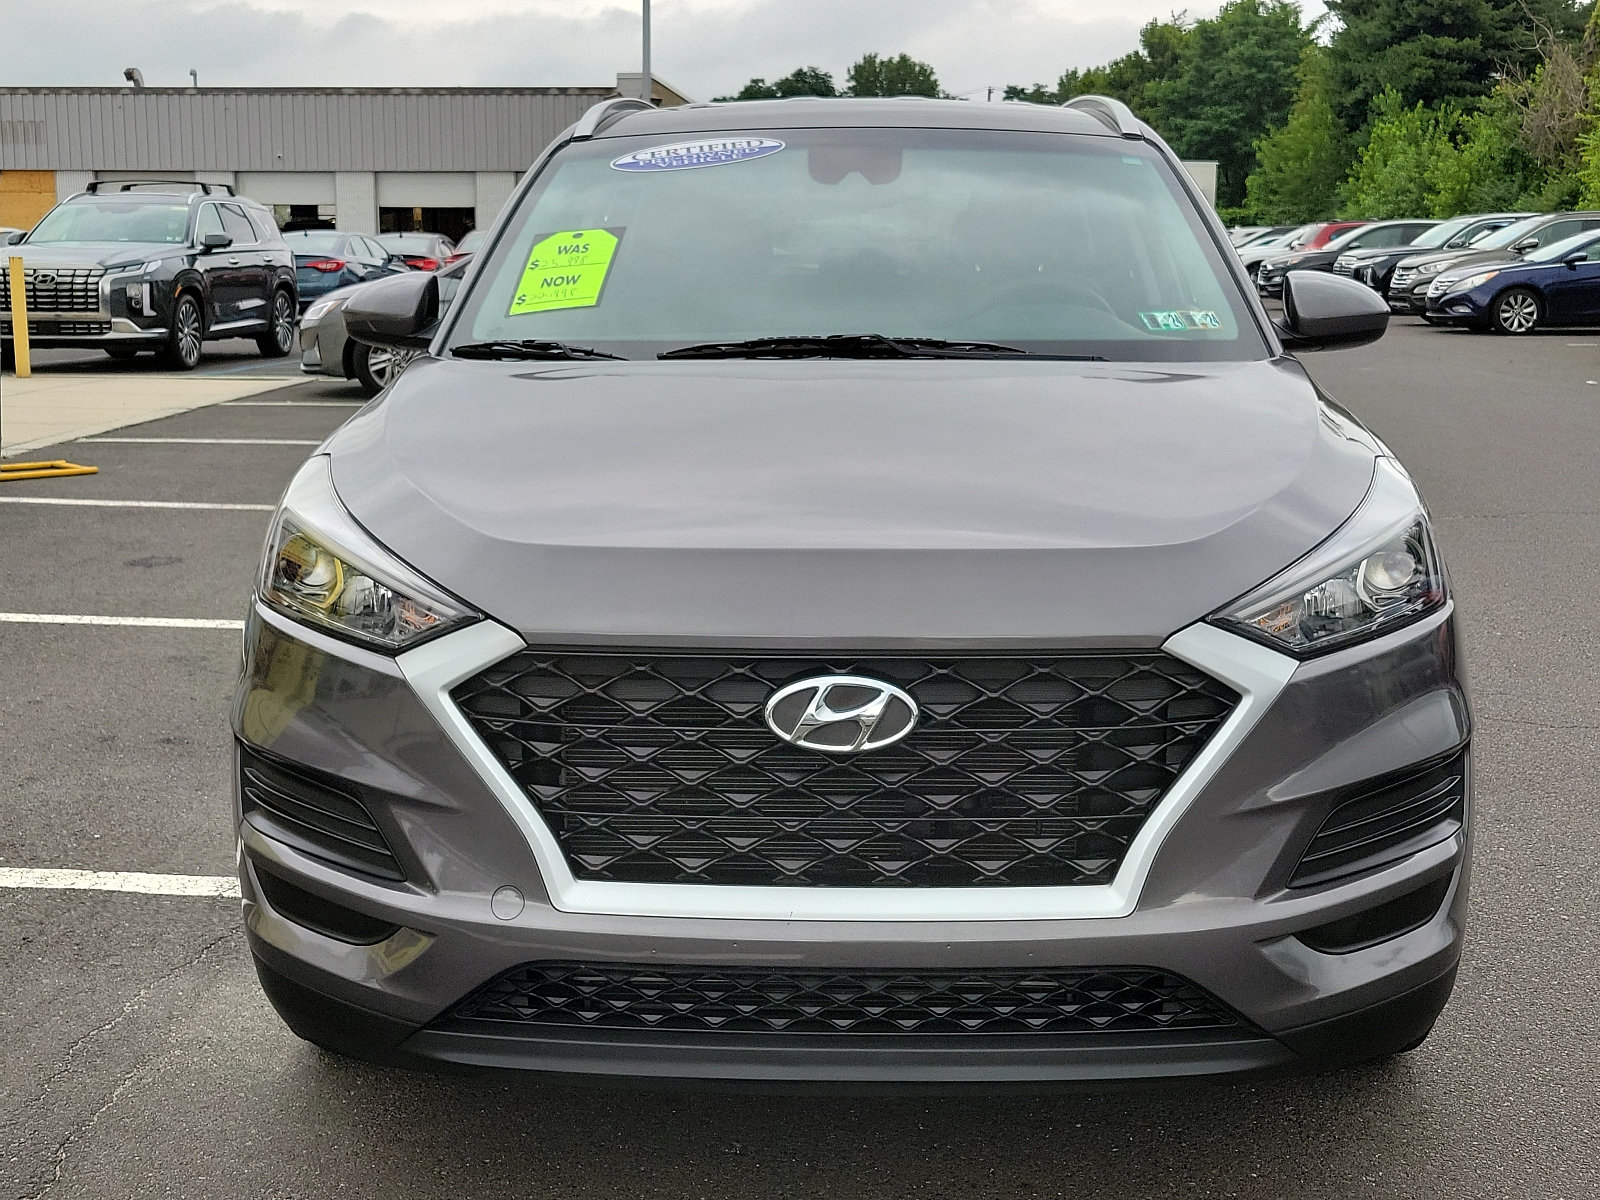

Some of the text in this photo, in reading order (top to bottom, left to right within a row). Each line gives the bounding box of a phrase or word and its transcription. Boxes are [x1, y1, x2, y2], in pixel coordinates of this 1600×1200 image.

[632, 139, 764, 160] CERTIFIED
[639, 147, 760, 166] PRE-OWNED
[657, 153, 744, 168] VEHICLE
[557, 243, 590, 255] WAS
[540, 274, 582, 289] NOW
